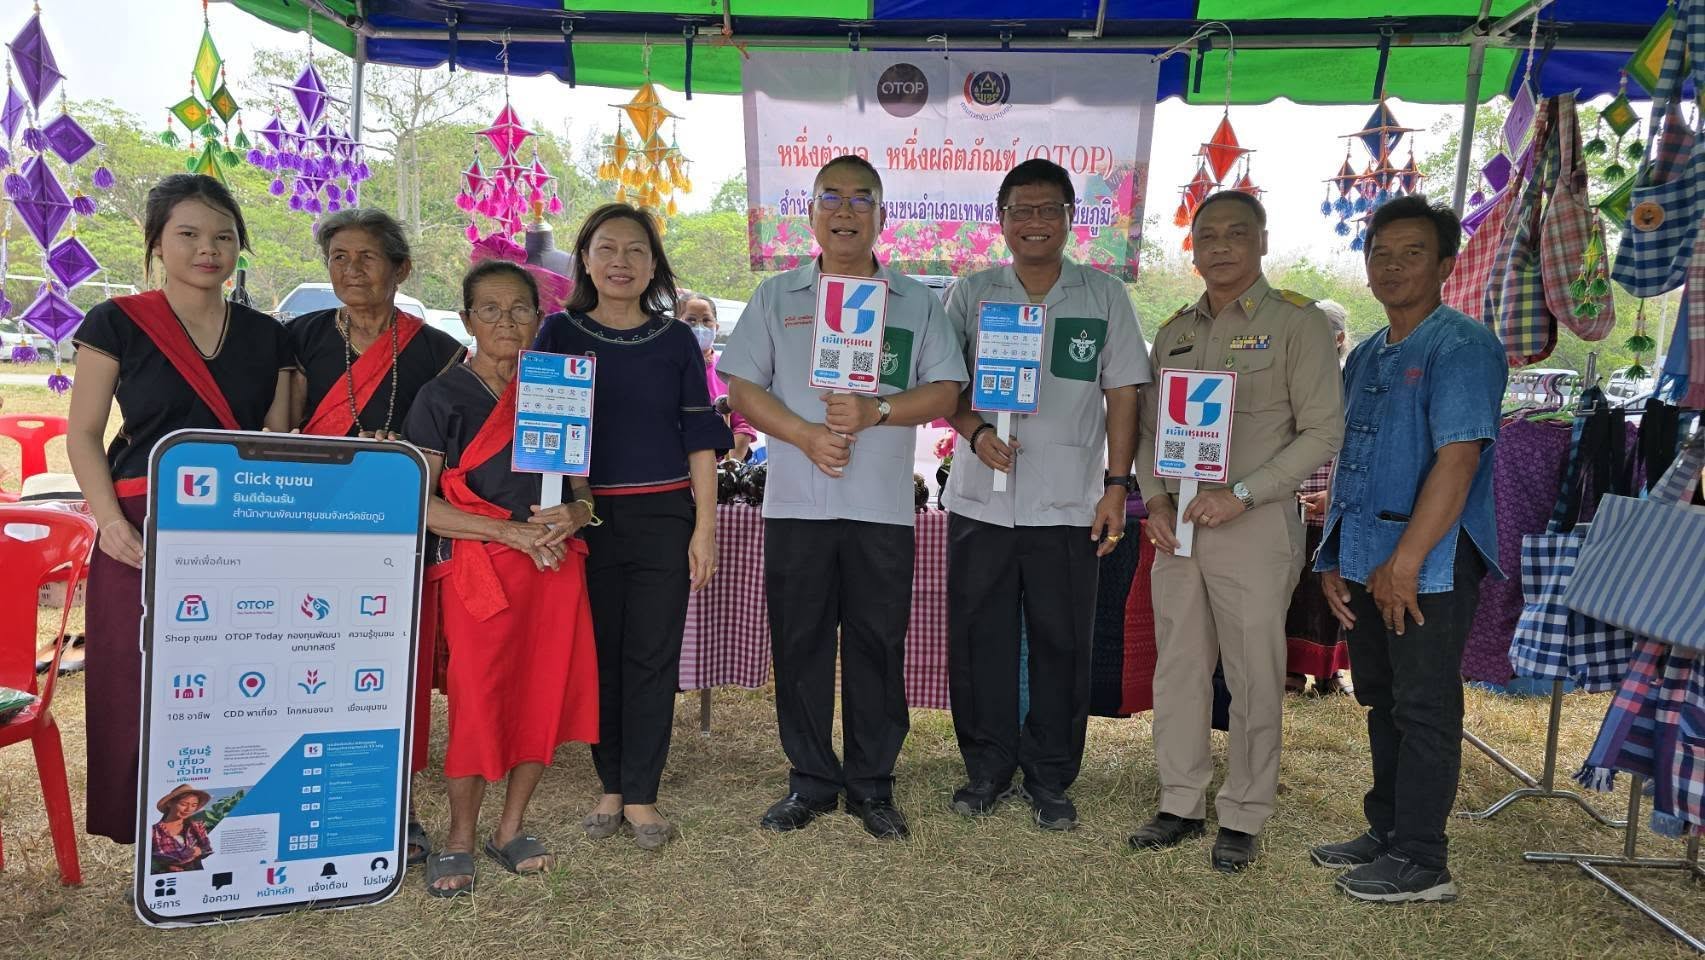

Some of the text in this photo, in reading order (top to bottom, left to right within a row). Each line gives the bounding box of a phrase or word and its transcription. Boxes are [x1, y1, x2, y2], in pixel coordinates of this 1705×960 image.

[882, 81, 924, 94] OTOP
[234, 472, 313, 489] Click ชุมชน
[233, 492, 294, 504] ยินดีต้อนรับ
[233, 508, 385, 523] สำนักงานพัฒนาชุมชนจังหวัดชัยภูมิ
[175, 554, 241, 566] พิมพ์เพื่อค้นหา
[237, 600, 274, 610] OTOP
[165, 634, 218, 644] Shop ชุมชน
[225, 632, 284, 642] OTOP Today
[287, 631, 341, 641] กองทุนพัฒนา
[348, 629, 395, 640] ความรู้ชุมชน
[291, 642, 336, 652] บทบาทสตรี
[223, 707, 278, 718] CDD พาเที่ยว
[287, 706, 334, 715] โคกหนองนา
[347, 703, 388, 713] เชื่อมชุมชน
[168, 711, 211, 721] 108 อาชีพ
[179, 745, 212, 756] เรียนรู้
[179, 755, 205, 766] เที่ยว
[176, 766, 211, 776] ทั่วไทย
[257, 886, 295, 898] หน้าหลัก
[308, 881, 349, 893] แจ้งเตือน
[202, 893, 240, 904] ข้อความ
[149, 900, 182, 911] บริการ
